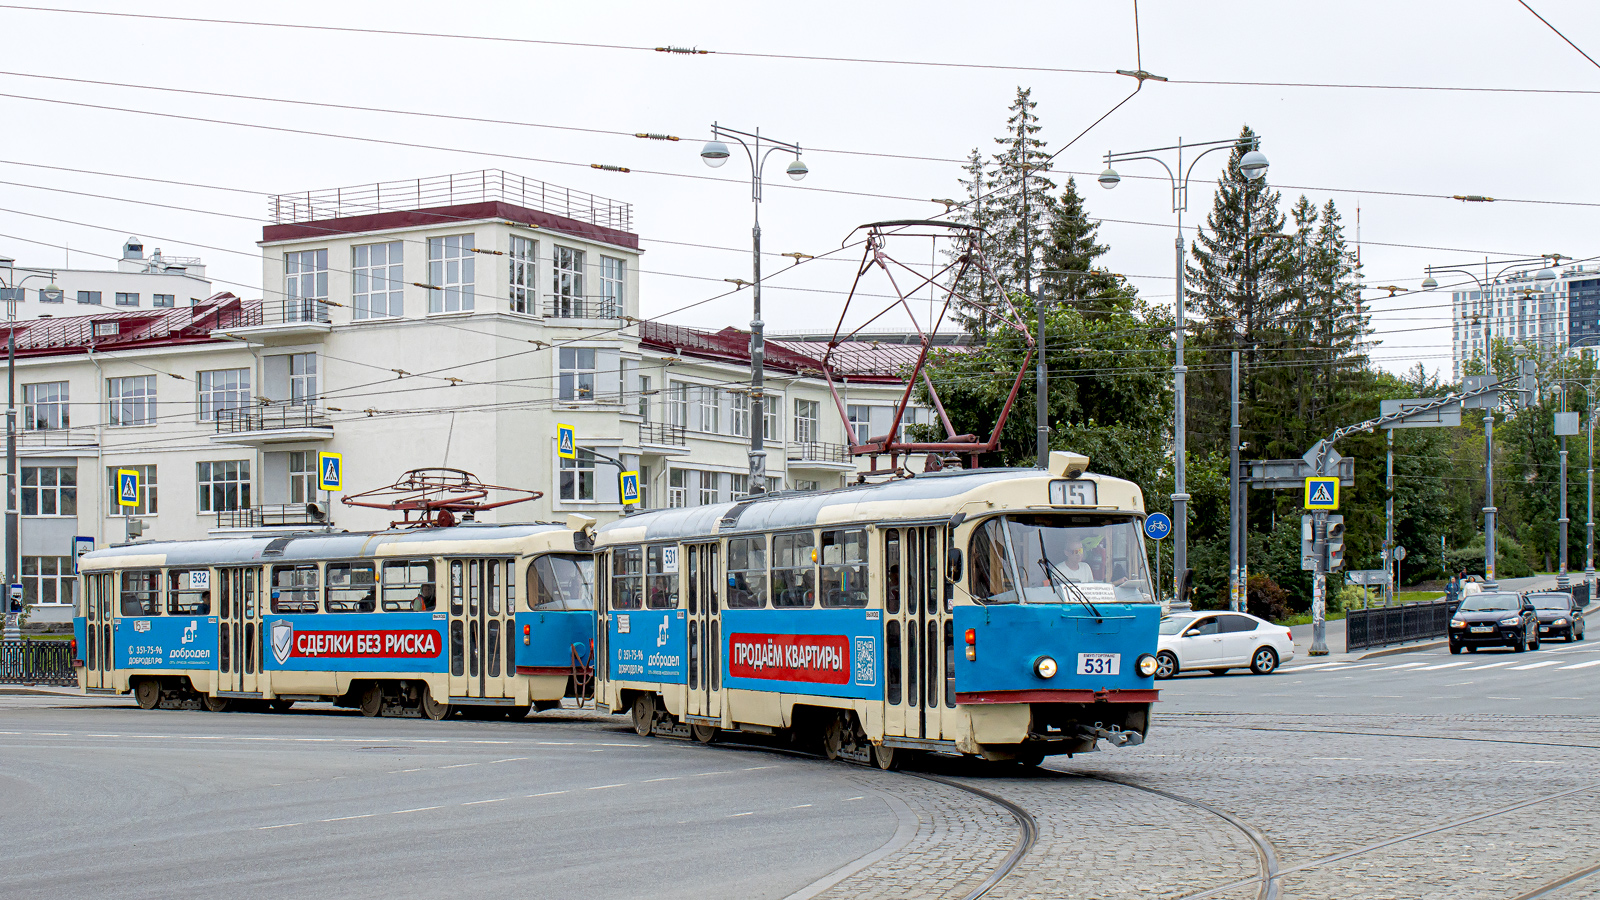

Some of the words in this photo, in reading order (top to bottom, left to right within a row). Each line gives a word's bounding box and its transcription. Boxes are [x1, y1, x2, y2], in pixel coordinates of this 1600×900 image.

[1058, 484, 1086, 505] 15
[665, 549, 676, 564] 531
[192, 572, 207, 583] 532
[136, 645, 163, 655] 351-75-96
[297, 634, 353, 656] СДЕЛКИ
[357, 634, 381, 654] БЕЗ
[385, 633, 436, 654] РИСКА
[128, 656, 163, 666] ДОБРОДЕЛ.РФ
[169, 647, 211, 660] добродел
[623, 649, 644, 661] 351-75-96
[647, 651, 680, 669] добродел
[734, 638, 783, 671] ПРОДАЁМ
[785, 645, 843, 671] КВАРТИРЫ
[1084, 658, 1112, 674] 531
